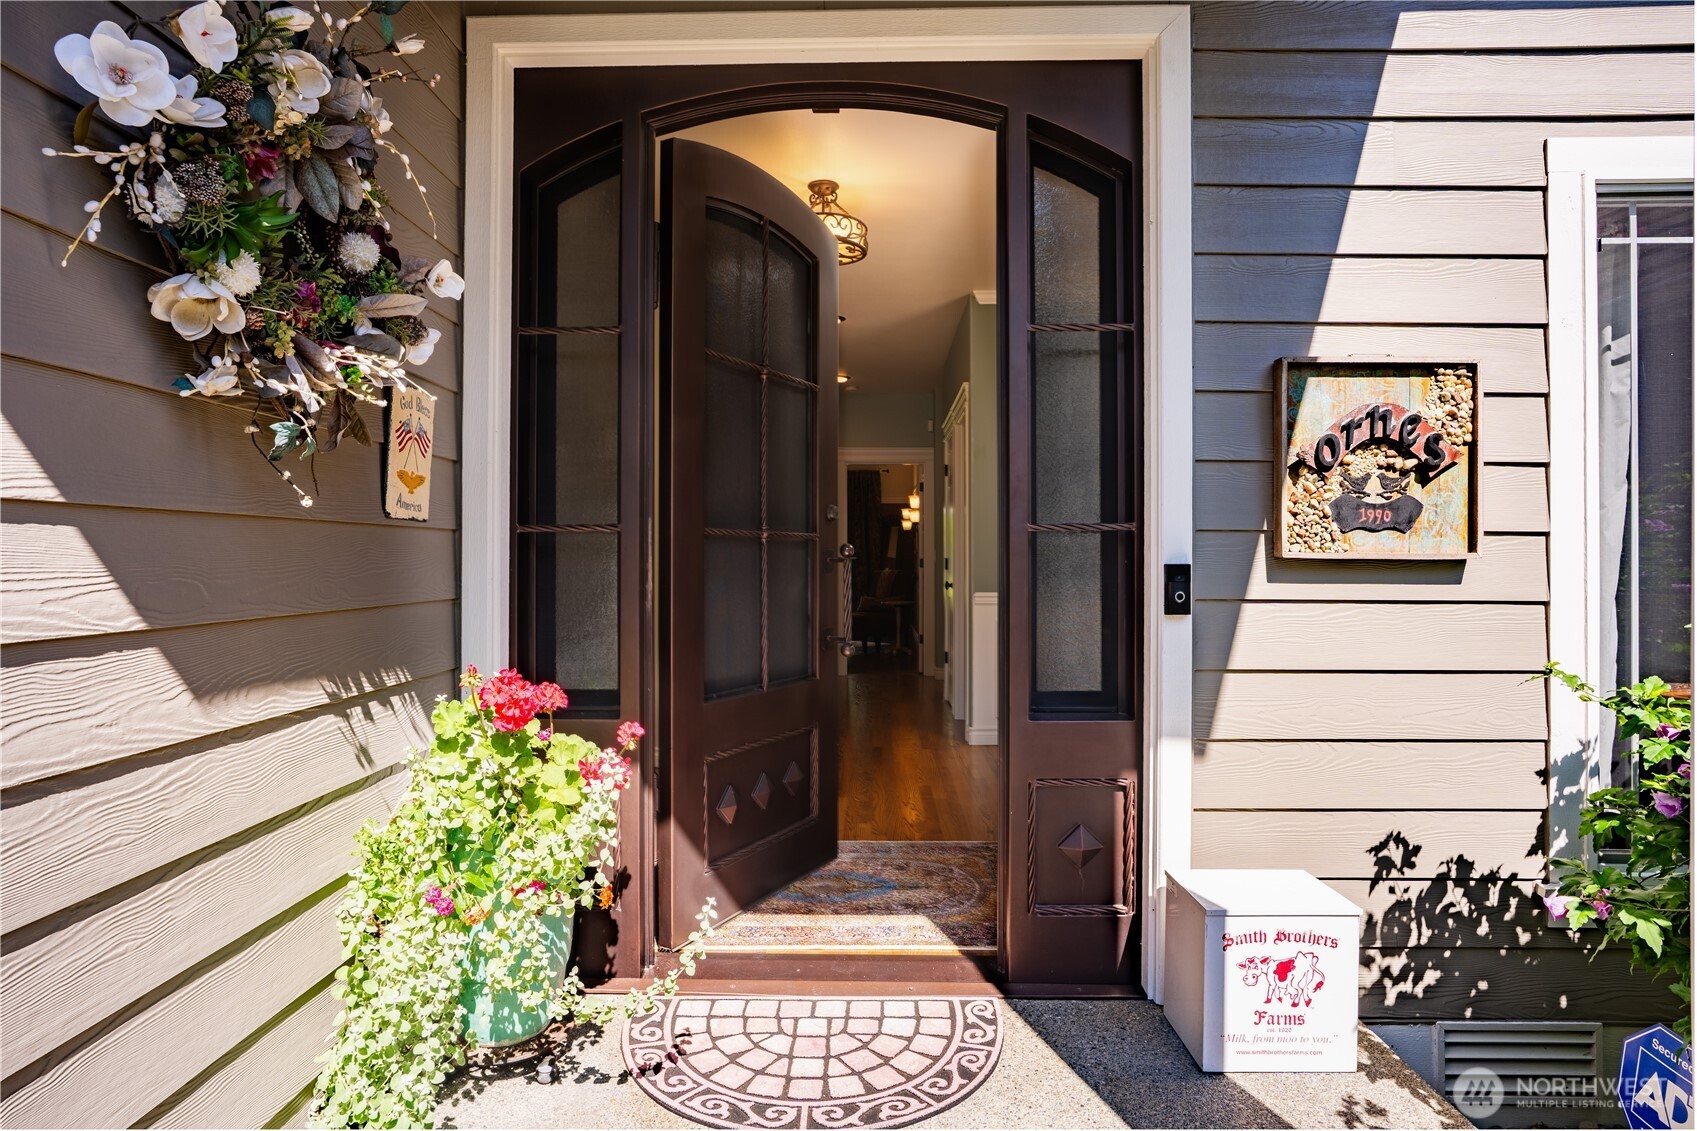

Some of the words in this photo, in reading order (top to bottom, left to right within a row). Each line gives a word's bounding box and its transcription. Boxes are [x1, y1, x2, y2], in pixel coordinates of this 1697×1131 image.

[399, 394, 414, 410] God
[396, 492, 422, 513] America
[1358, 507, 1393, 525] 1990
[1222, 929, 1267, 952] Smith
[1273, 928, 1341, 949] Brothers
[1253, 1010, 1307, 1026] Farms
[1250, 1034, 1275, 1045] from
[1299, 1035, 1310, 1043] to
[1634, 1071, 1693, 1130] AD
